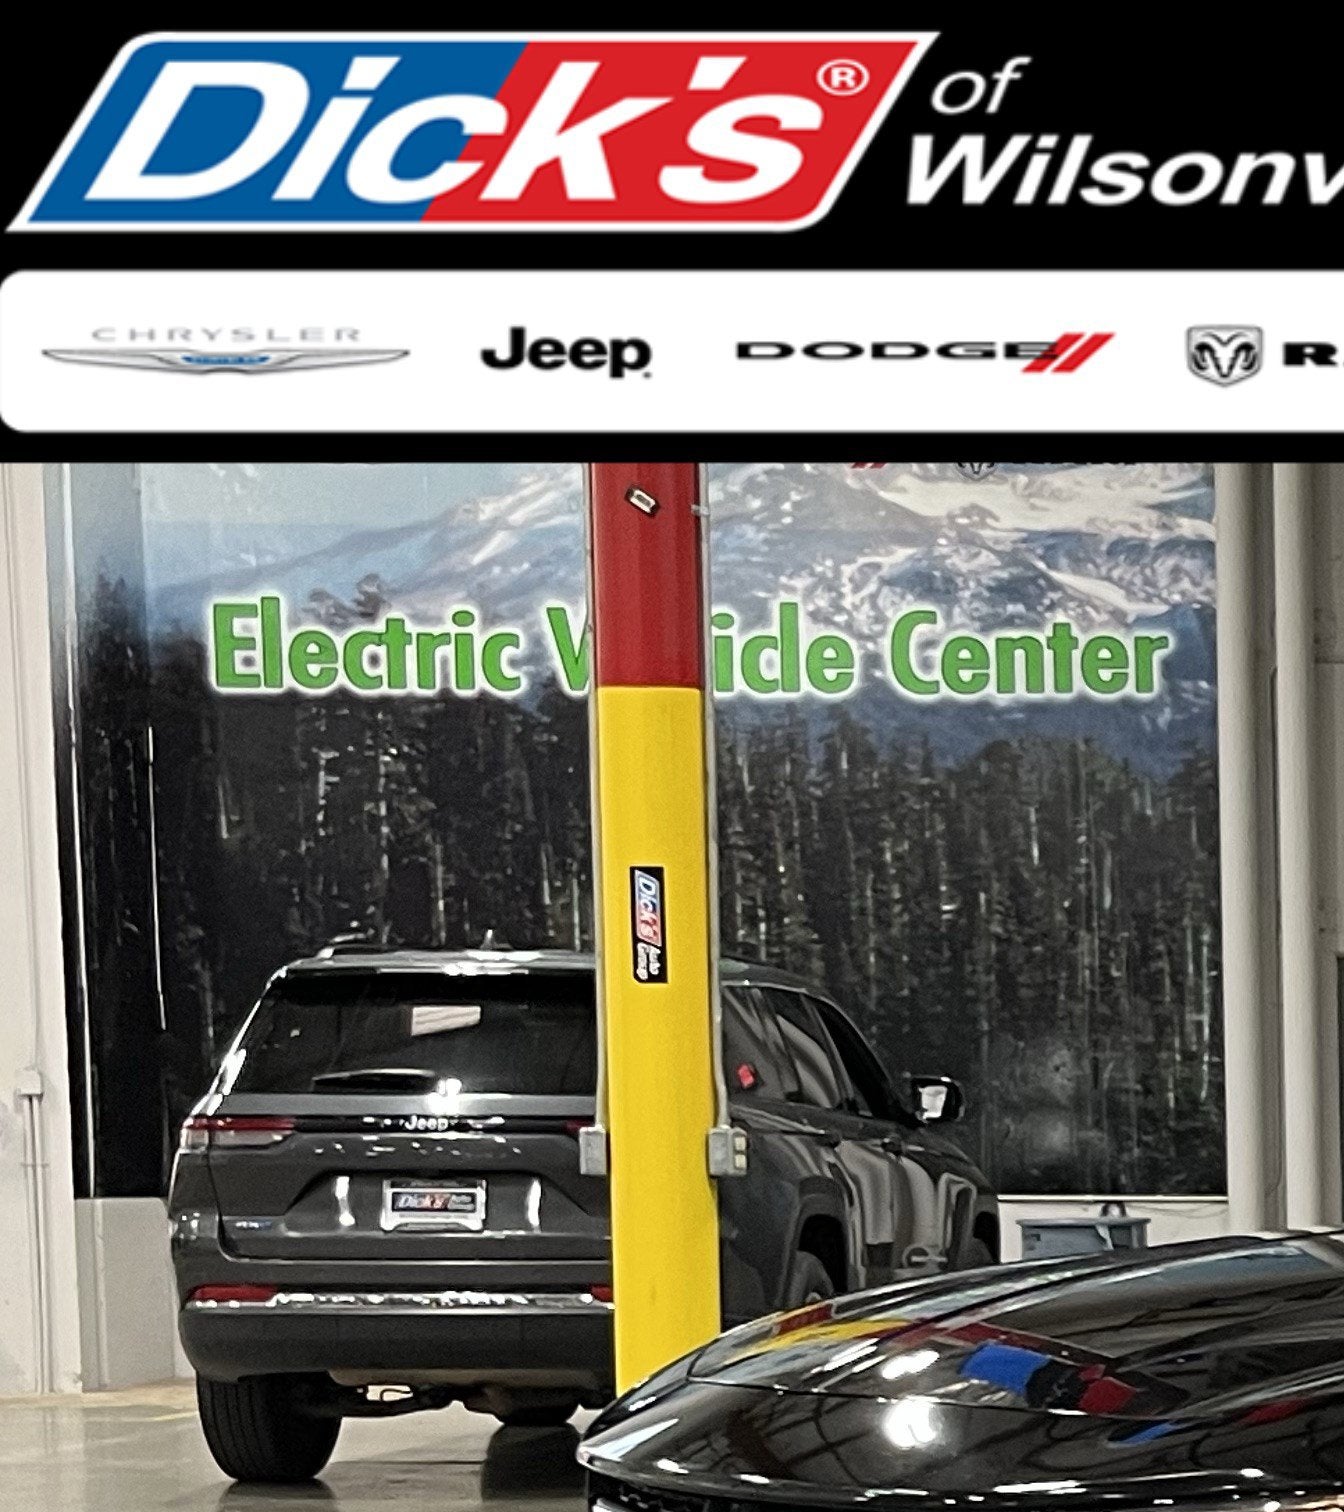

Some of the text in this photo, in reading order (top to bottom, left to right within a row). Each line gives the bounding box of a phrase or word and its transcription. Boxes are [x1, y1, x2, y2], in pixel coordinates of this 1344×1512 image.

[213, 596, 1168, 694] Electric Vicle Center
[405, 1115, 448, 1130] Jeep
